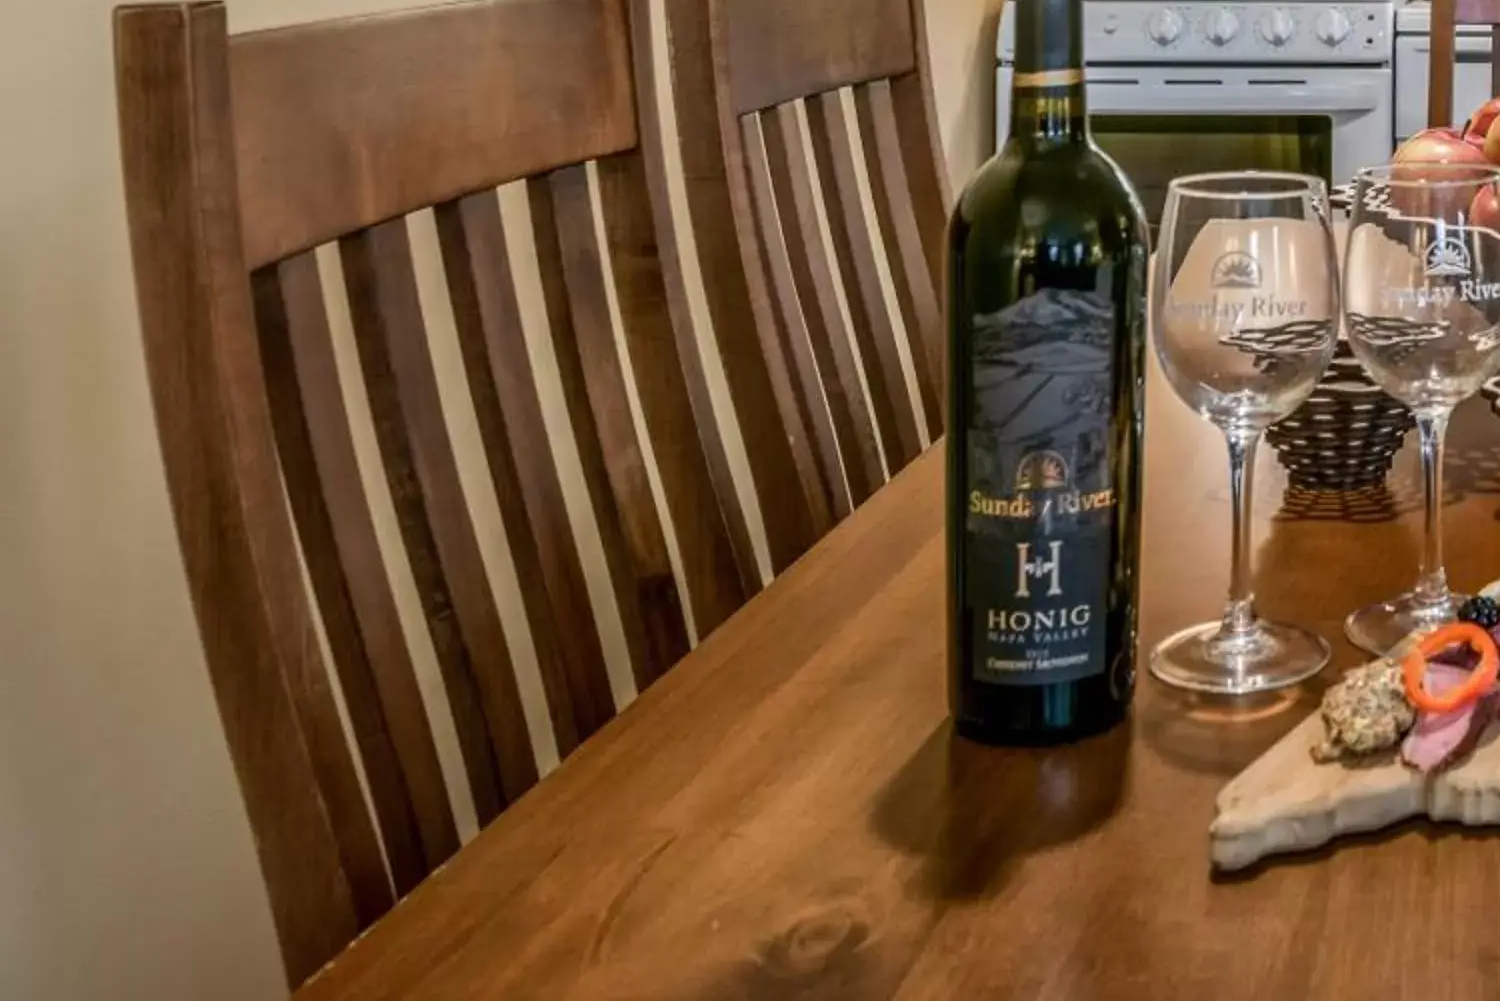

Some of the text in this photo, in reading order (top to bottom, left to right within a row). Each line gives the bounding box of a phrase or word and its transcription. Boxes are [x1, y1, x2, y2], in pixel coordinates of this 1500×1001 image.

[1168, 290, 1308, 324] nday River
[987, 604, 1091, 632] HONIG
